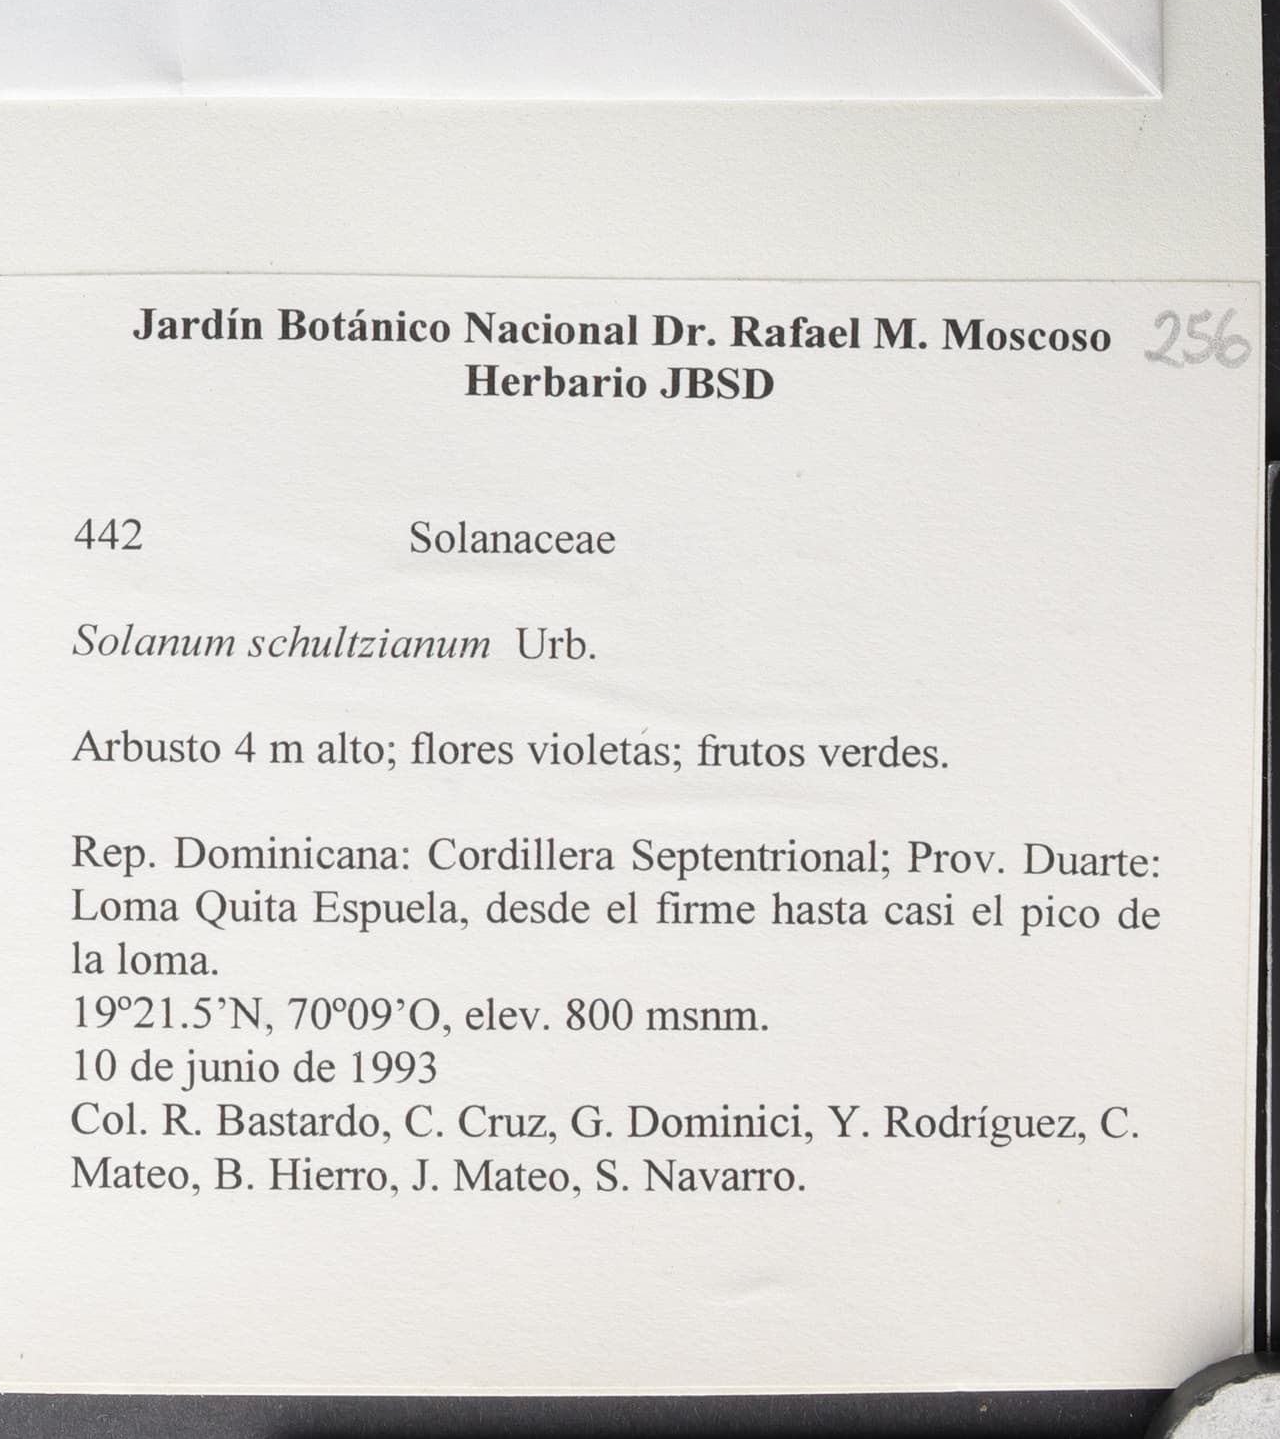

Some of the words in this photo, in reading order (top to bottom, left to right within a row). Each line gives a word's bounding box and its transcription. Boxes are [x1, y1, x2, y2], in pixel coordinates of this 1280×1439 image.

[132, 307, 263, 340] Jardín
[277, 308, 451, 343] Botánico
[464, 311, 638, 346] Nacional
[652, 314, 716, 347] Dr.
[730, 315, 861, 349] Rafael
[873, 317, 928, 350] M.
[942, 318, 1111, 352] Moscoso
[1145, 310, 1250, 367] 256
[465, 364, 647, 399] Herbario
[660, 367, 774, 400] JBSD
[74, 518, 143, 550] 442
[410, 520, 616, 555] Solanaceae
[72, 623, 235, 657] Solanum
[247, 625, 490, 659] schultzianum
[516, 627, 596, 660] Urb.
[72, 729, 221, 763] Arbusto
[234, 731, 256, 763] 4
[270, 741, 303, 764] m
[317, 731, 396, 771] alto;
[411, 731, 514, 765] flores
[527, 732, 682, 772] violetas;
[697, 733, 805, 768] frutos
[818, 735, 948, 769] verdes.
[72, 835, 155, 878] Rep.
[175, 836, 409, 870] Dominicana:
[428, 837, 614, 871] Cordillera
[632, 838, 890, 881] Septentrional;
[908, 840, 1004, 874] Prov.
[1024, 843, 1159, 878] Duarte:
[72, 888, 179, 922] Loma
[195, 889, 297, 930] Quita
[313, 890, 469, 933] Espuela,
[486, 890, 590, 924] desde
[607, 891, 638, 924] el
[657, 891, 755, 925] firme
[772, 891, 868, 925] hasta
[884, 893, 954, 926] casi
[972, 893, 1003, 926] el
[1021, 895, 1100, 937] pico
[1118, 897, 1161, 931] de
[72, 941, 104, 975] la
[118, 941, 218, 976] loma.
[465, 997, 549, 1031] elev.
[566, 998, 633, 1031] 800
[646, 1007, 768, 1031] msnm.
[75, 1048, 117, 1082] 10
[130, 1048, 174, 1083] de
[181, 1048, 280, 1092] junio
[293, 1049, 336, 1083] de
[353, 1050, 437, 1084] 1993
[71, 1102, 147, 1135] Col.
[162, 1103, 201, 1136] R.
[217, 1103, 391, 1141] Bastardo,
[405, 1104, 443, 1138] C.
[458, 1104, 557, 1143] Cruz,
[571, 1104, 612, 1138] G.
[628, 1104, 813, 1144] Dominici,
[827, 1105, 869, 1138] Y.
[884, 1104, 1086, 1148] Rodríguez,
[1100, 1106, 1138, 1139] C.
[71, 1156, 200, 1195] Mateo,
[215, 1157, 254, 1190] B.
[270, 1157, 399, 1192] Hierro,
[412, 1158, 438, 1191] J.
[454, 1159, 581, 1193] Mateo,
[596, 1158, 629, 1192] S.
[643, 1159, 805, 1192] Navarro.
